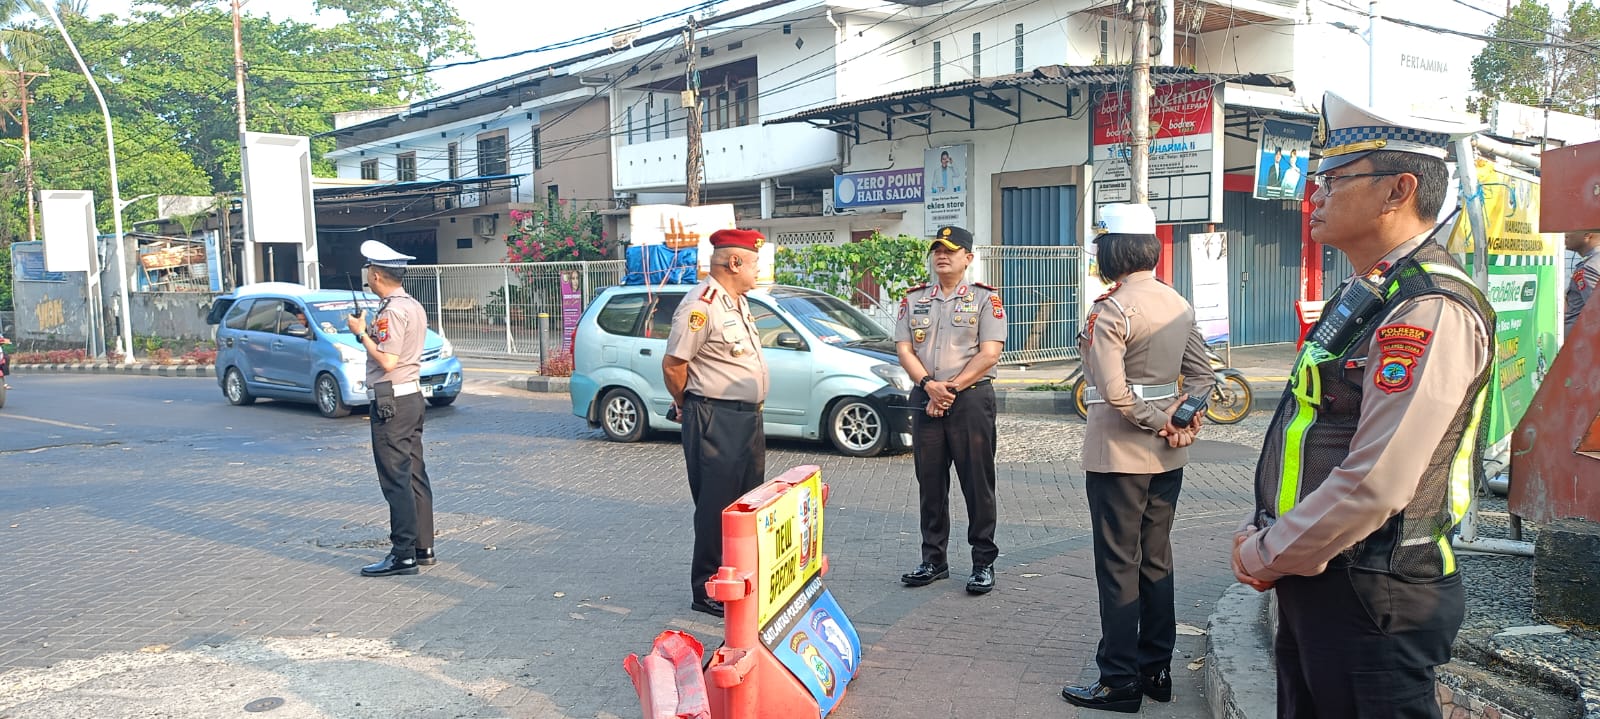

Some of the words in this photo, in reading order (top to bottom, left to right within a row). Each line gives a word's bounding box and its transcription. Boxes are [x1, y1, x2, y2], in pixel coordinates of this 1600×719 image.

[1401, 53, 1448, 73] PERTAMINA
[857, 175, 885, 189] ZERO
[888, 173, 922, 187] POINT
[857, 190, 883, 202] HAIR
[886, 187, 922, 200] SALON
[946, 201, 965, 209] store
[1381, 327, 1425, 337] POLRESTA
[765, 509, 777, 529] ABC
[775, 518, 793, 560] NEW
[769, 554, 797, 605] SPECIAL
